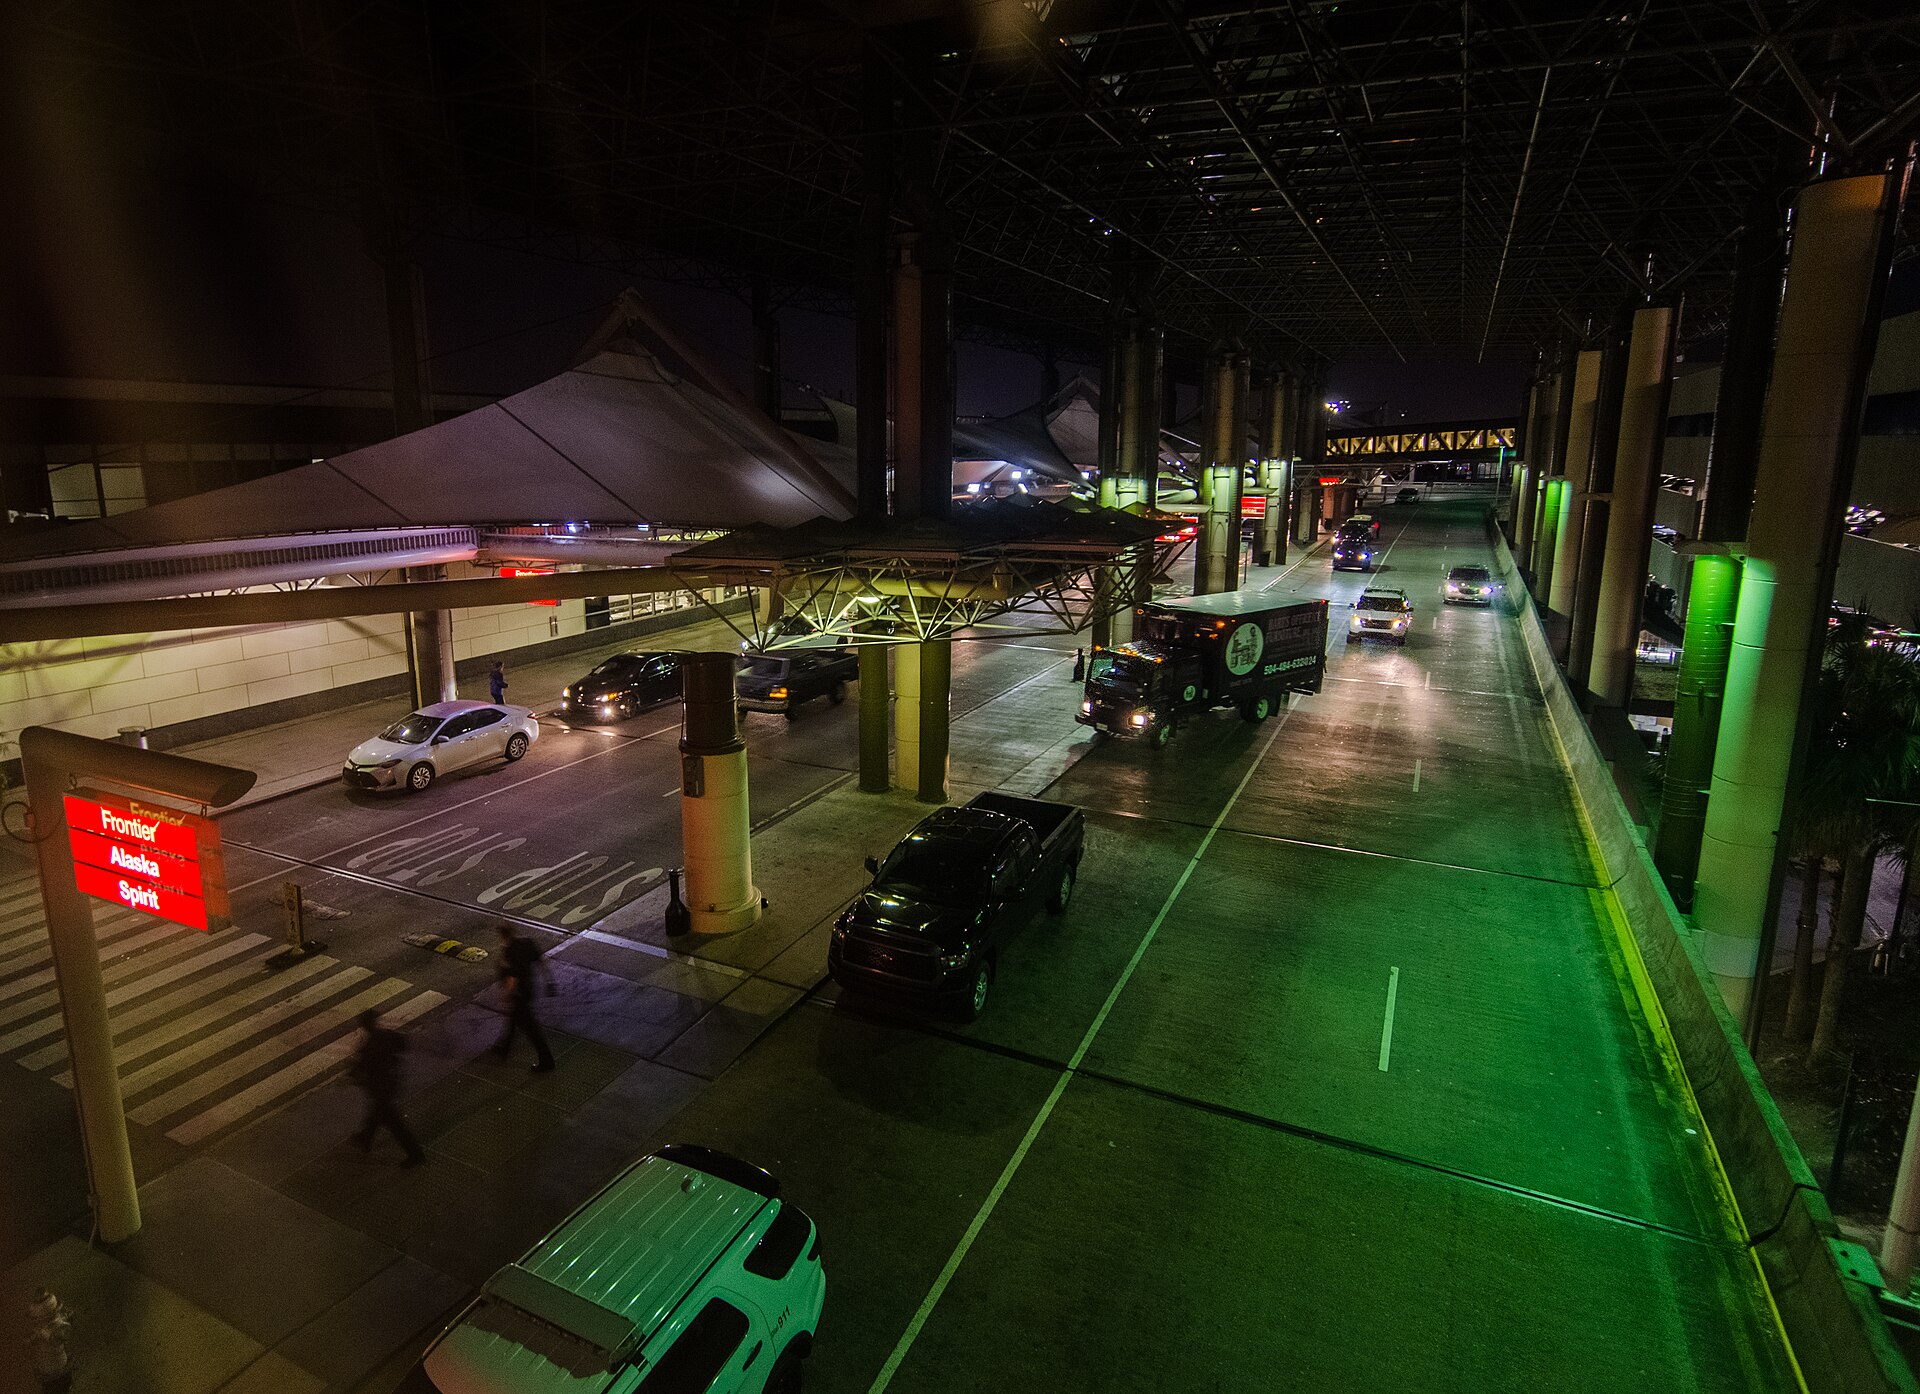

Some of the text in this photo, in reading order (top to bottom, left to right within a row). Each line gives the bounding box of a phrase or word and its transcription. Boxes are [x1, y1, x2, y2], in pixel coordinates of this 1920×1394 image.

[100, 806, 160, 843] Frontier
[110, 845, 160, 878] Alaska
[346, 823, 527, 887] STOP
[118, 880, 160, 911] Spirit
[476, 851, 664, 925] STOP
[777, 1304, 790, 1328] 911
